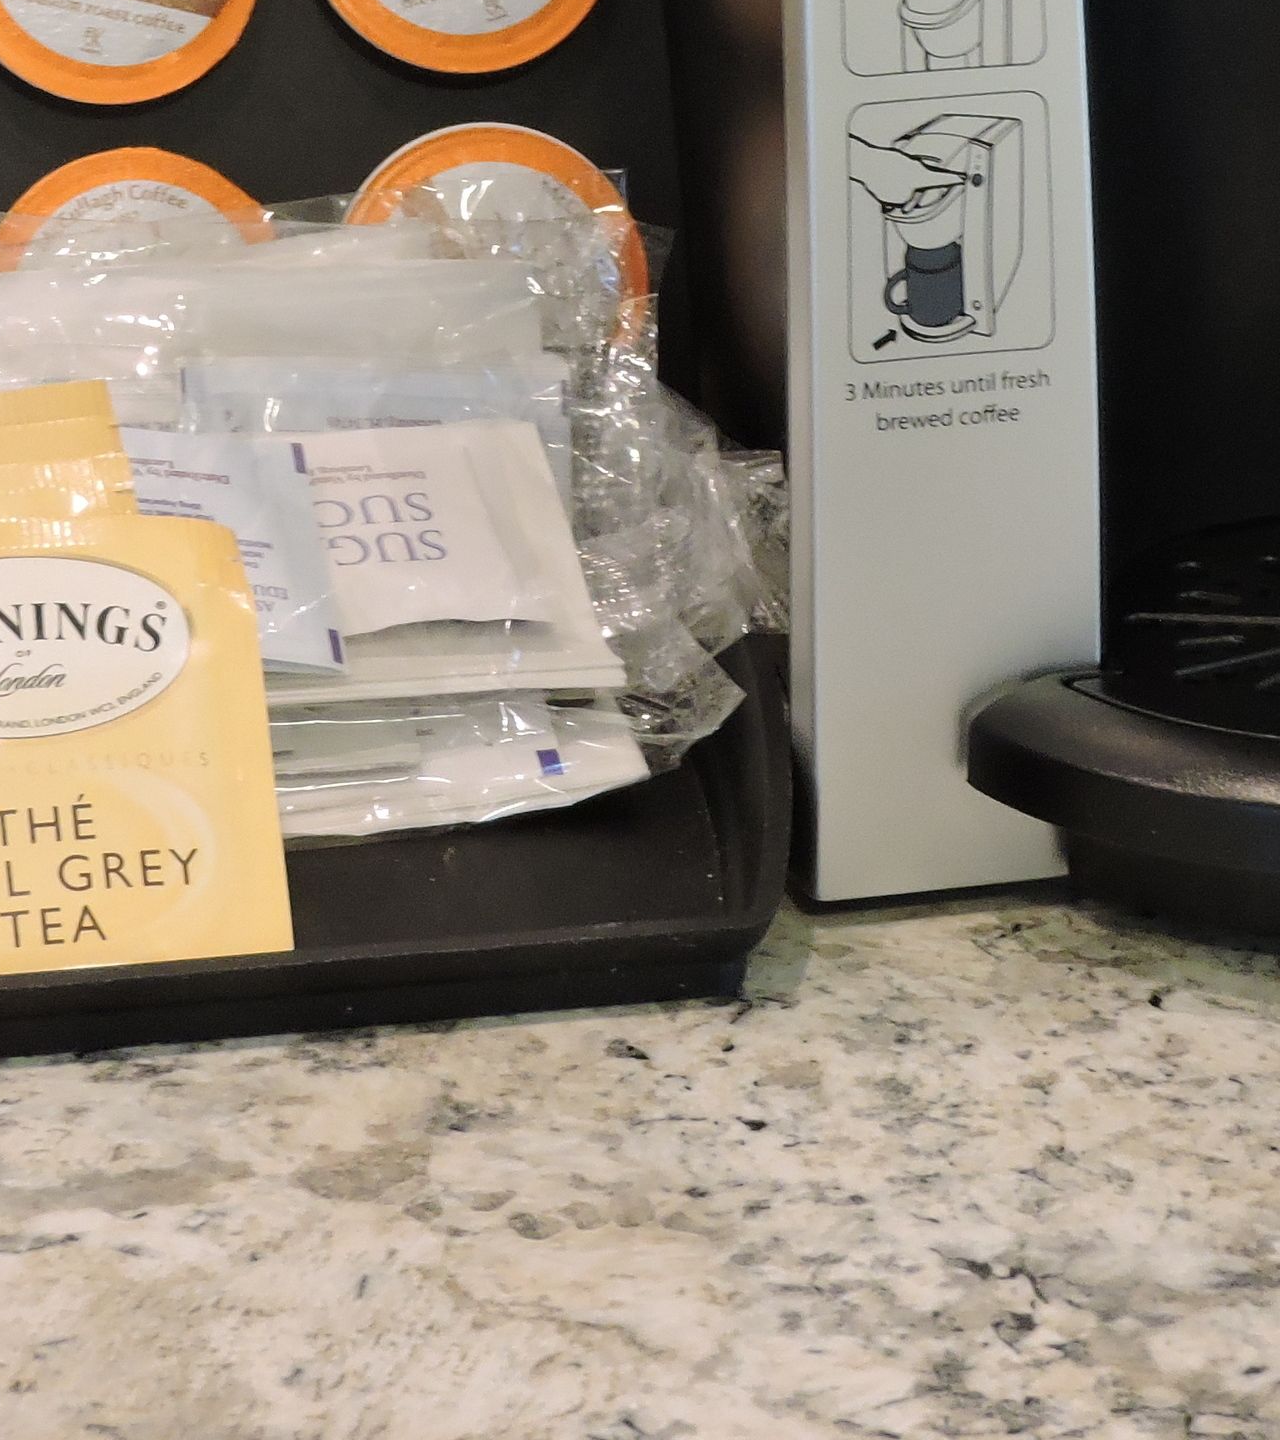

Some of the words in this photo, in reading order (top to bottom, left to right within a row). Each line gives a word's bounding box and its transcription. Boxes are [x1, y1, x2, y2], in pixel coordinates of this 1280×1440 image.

[844, 382, 857, 401] 3
[862, 381, 945, 400] Minutes
[950, 372, 996, 395] until
[1000, 368, 1051, 390] fresh
[875, 406, 954, 431] brewed
[959, 403, 1022, 425] coffee
[312, 492, 433, 528] SUC
[320, 529, 447, 566] SUG
[15, 650, 31, 658] OF
[35, 709, 87, 728] LONDON
[117, 671, 163, 706] ENGLAND
[58, 848, 198, 892] GREY
[0, 906, 107, 950] TEA
